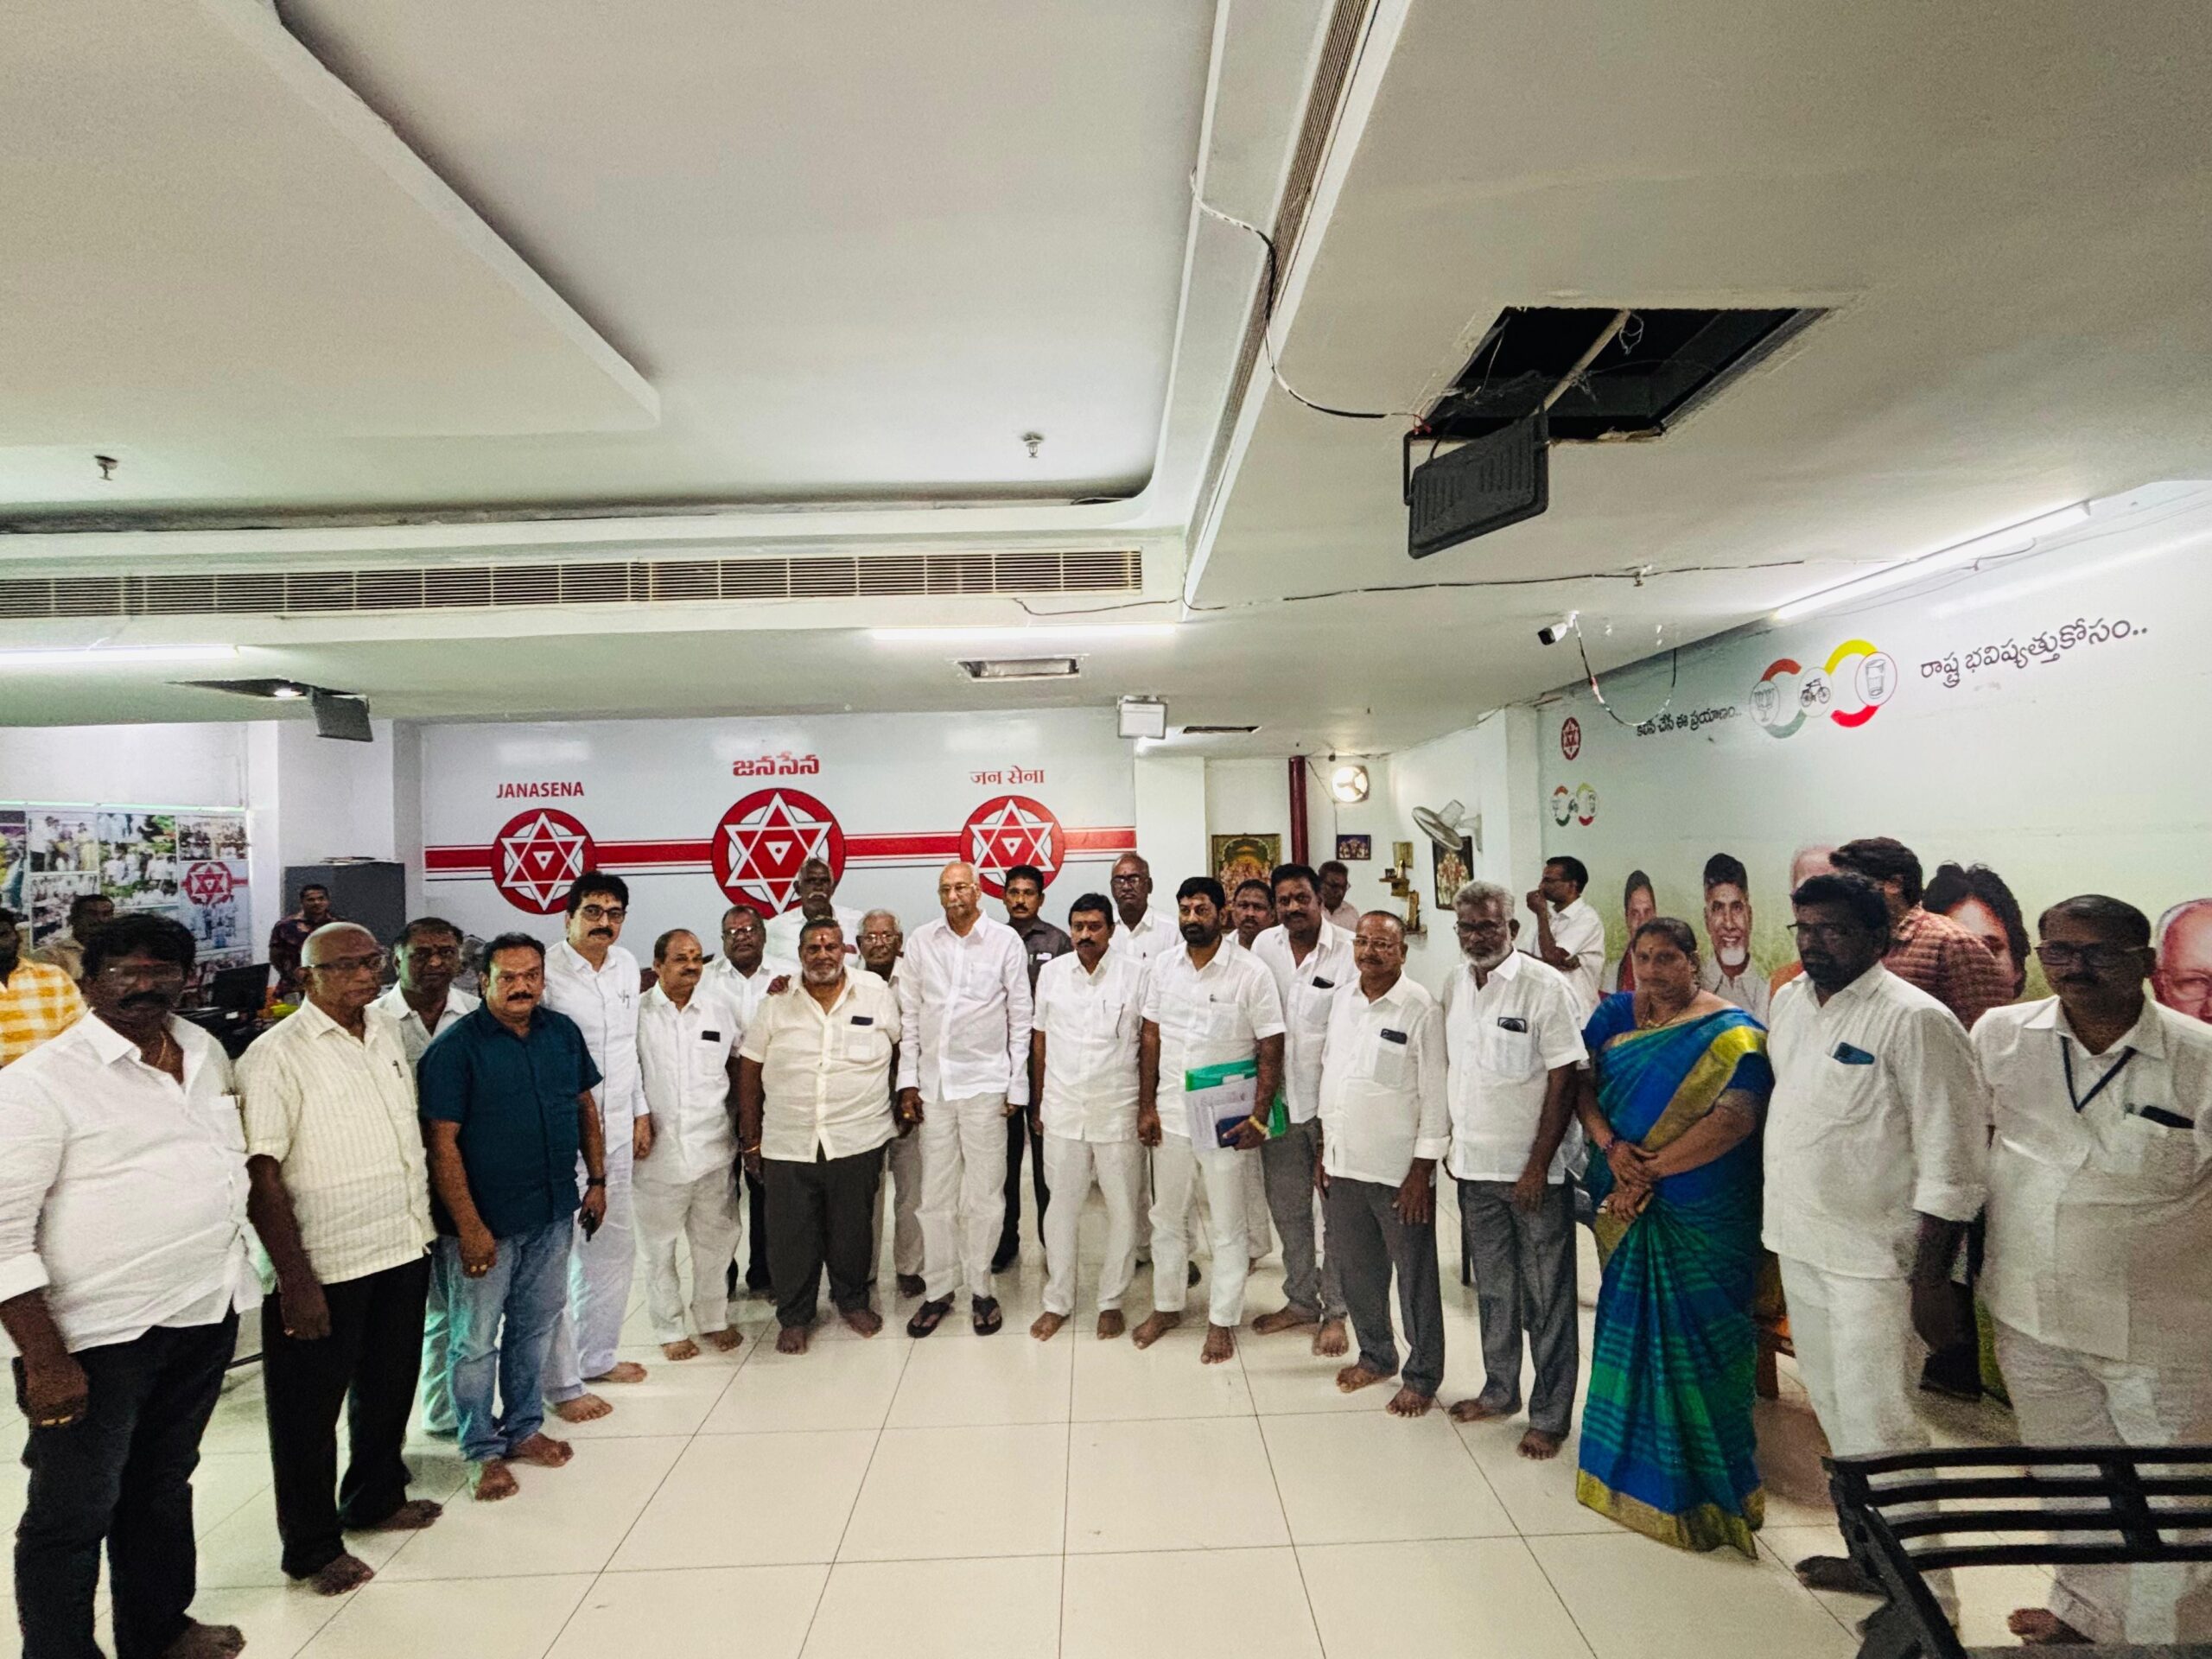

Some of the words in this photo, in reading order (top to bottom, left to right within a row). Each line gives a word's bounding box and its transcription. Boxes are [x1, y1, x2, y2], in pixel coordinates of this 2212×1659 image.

[969, 771, 1002, 785] जन
[1007, 765, 1045, 784] सेना
[496, 781, 585, 798] JANASENA
